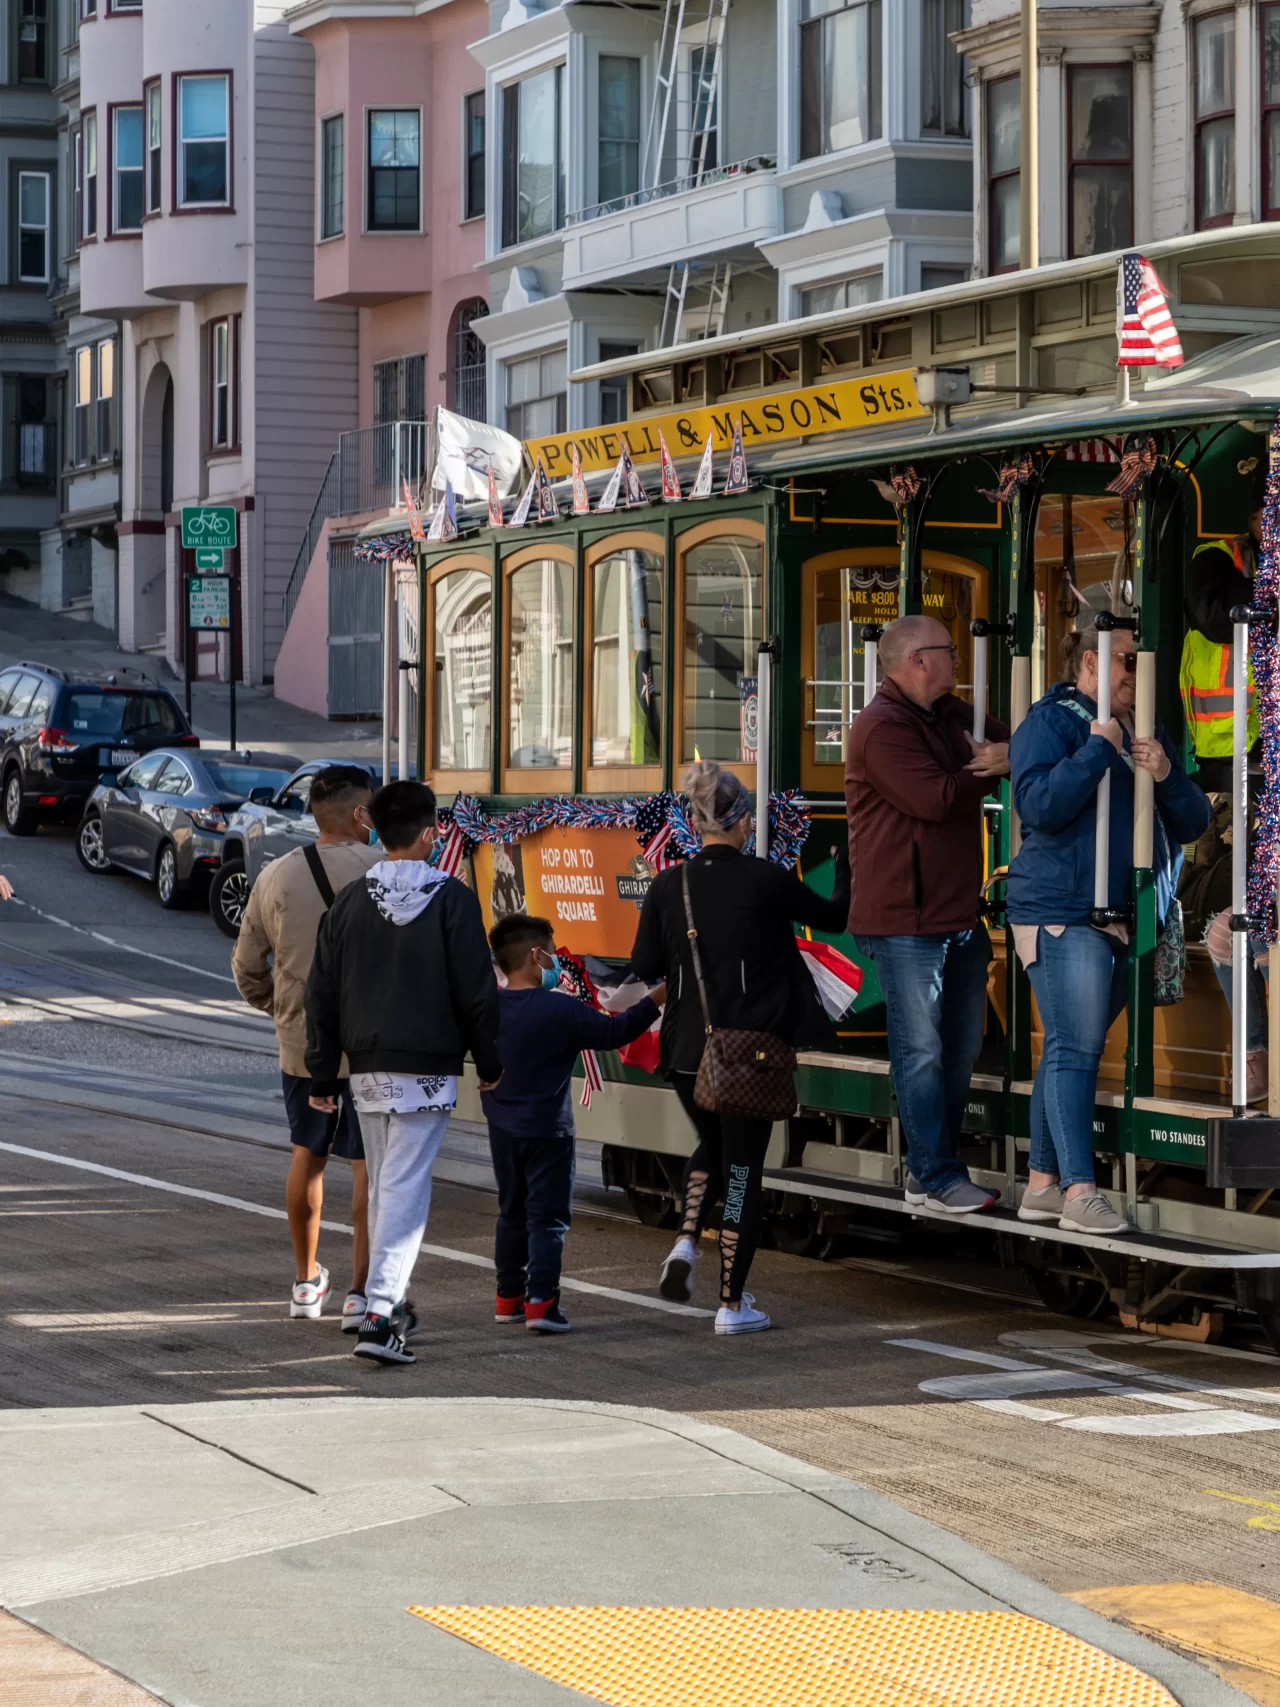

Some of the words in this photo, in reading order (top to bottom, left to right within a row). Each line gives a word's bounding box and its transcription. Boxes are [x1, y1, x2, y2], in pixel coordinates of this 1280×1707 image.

[541, 426, 661, 470] POWELL
[677, 419, 702, 448] &
[711, 393, 842, 441] MASON
[859, 384, 913, 416] Sts.
[187, 536, 204, 545] BIKE
[207, 536, 232, 545] ROUTE
[191, 580, 200, 591] 2
[922, 594, 945, 607] WAY
[540, 847, 561, 868] HOP
[563, 848, 578, 868] ON
[580, 848, 594, 869] TO
[541, 874, 604, 895] GHIRARDELLI
[556, 901, 597, 922] SQUARE
[968, 1104, 985, 1115] ONLY
[1092, 1121, 1106, 1133] NLY
[1150, 1128, 1168, 1142] TWO
[1169, 1131, 1206, 1147] STANDEES
[723, 1164, 749, 1223] PINK
